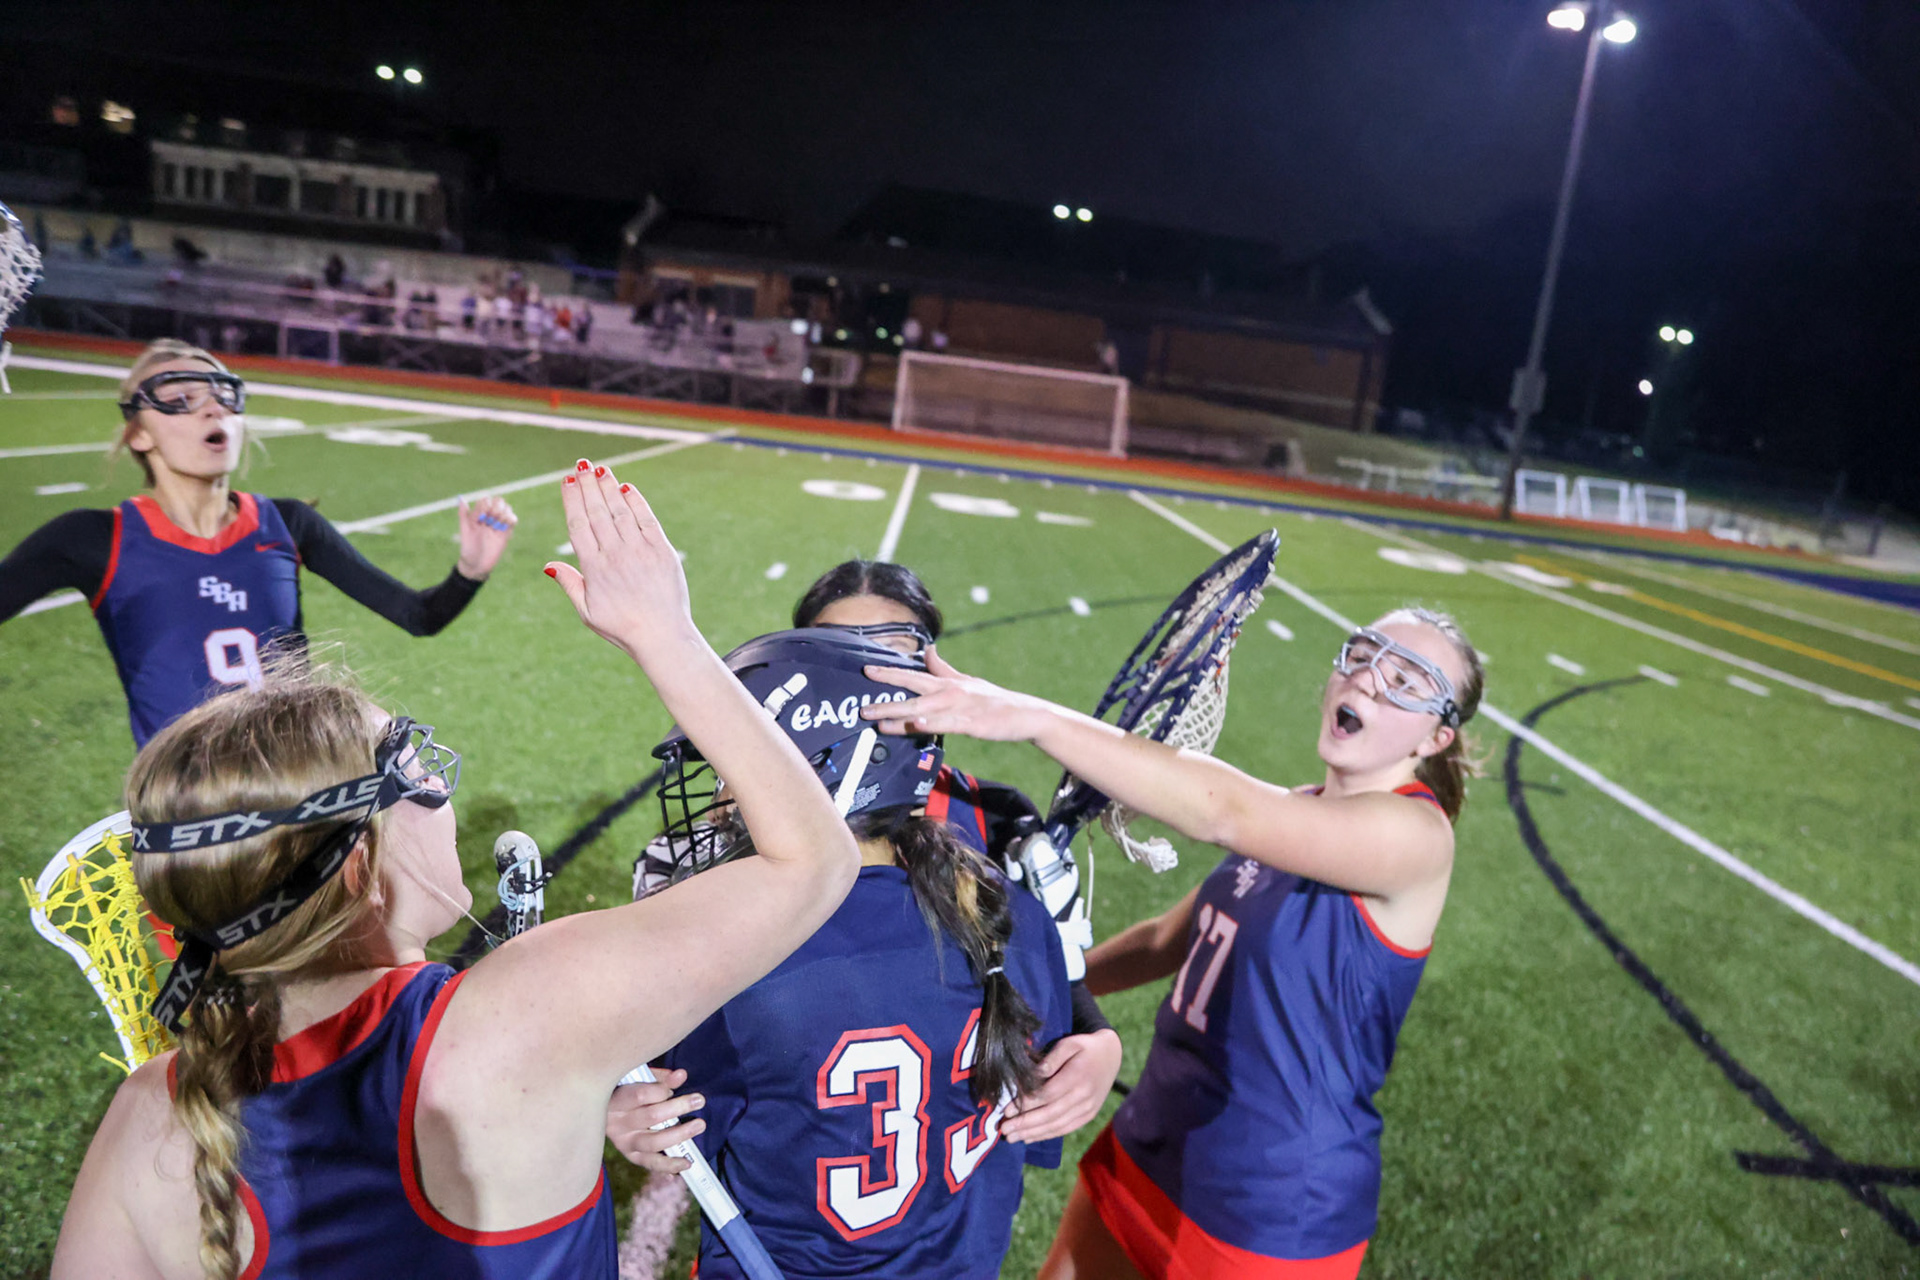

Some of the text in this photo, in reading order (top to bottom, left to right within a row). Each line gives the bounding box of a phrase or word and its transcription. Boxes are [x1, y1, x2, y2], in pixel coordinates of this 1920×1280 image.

[791, 691, 907, 732] EAG
[297, 775, 386, 820] STX
[169, 810, 272, 850] STX
[216, 891, 298, 946] STX
[153, 961, 203, 1028] STX
